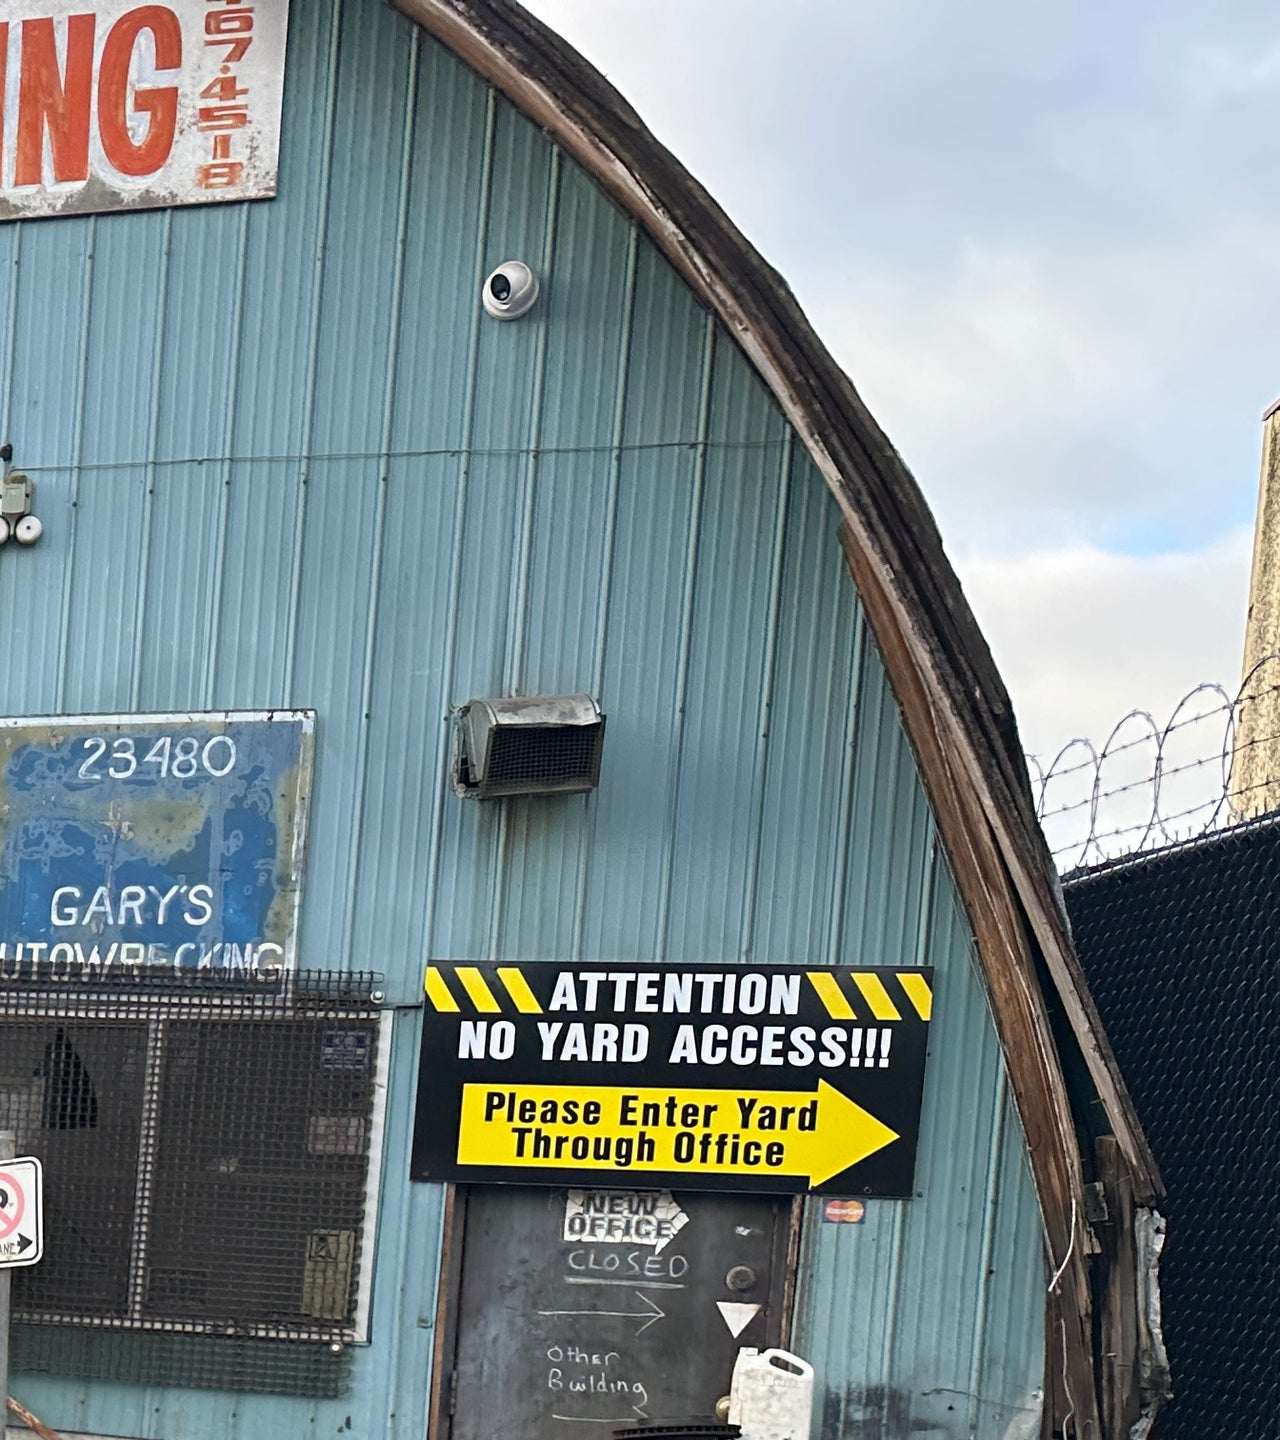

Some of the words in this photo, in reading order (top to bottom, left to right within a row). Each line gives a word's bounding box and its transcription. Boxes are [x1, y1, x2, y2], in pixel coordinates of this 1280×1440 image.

[77, 736, 237, 780] 23480
[50, 884, 214, 926] GARY'S
[549, 971, 801, 1016] ATTENTION
[458, 1020, 516, 1060] NO
[537, 1022, 650, 1063] YARD
[668, 1025, 893, 1068] ACCESS!!!
[484, 1091, 601, 1125] Please
[619, 1095, 719, 1129] Enter
[739, 1098, 819, 1132] Yard
[512, 1128, 656, 1168] Through
[673, 1133, 785, 1167] Office
[584, 1194, 657, 1216] NEW
[568, 1249, 689, 1278] CLOSED
